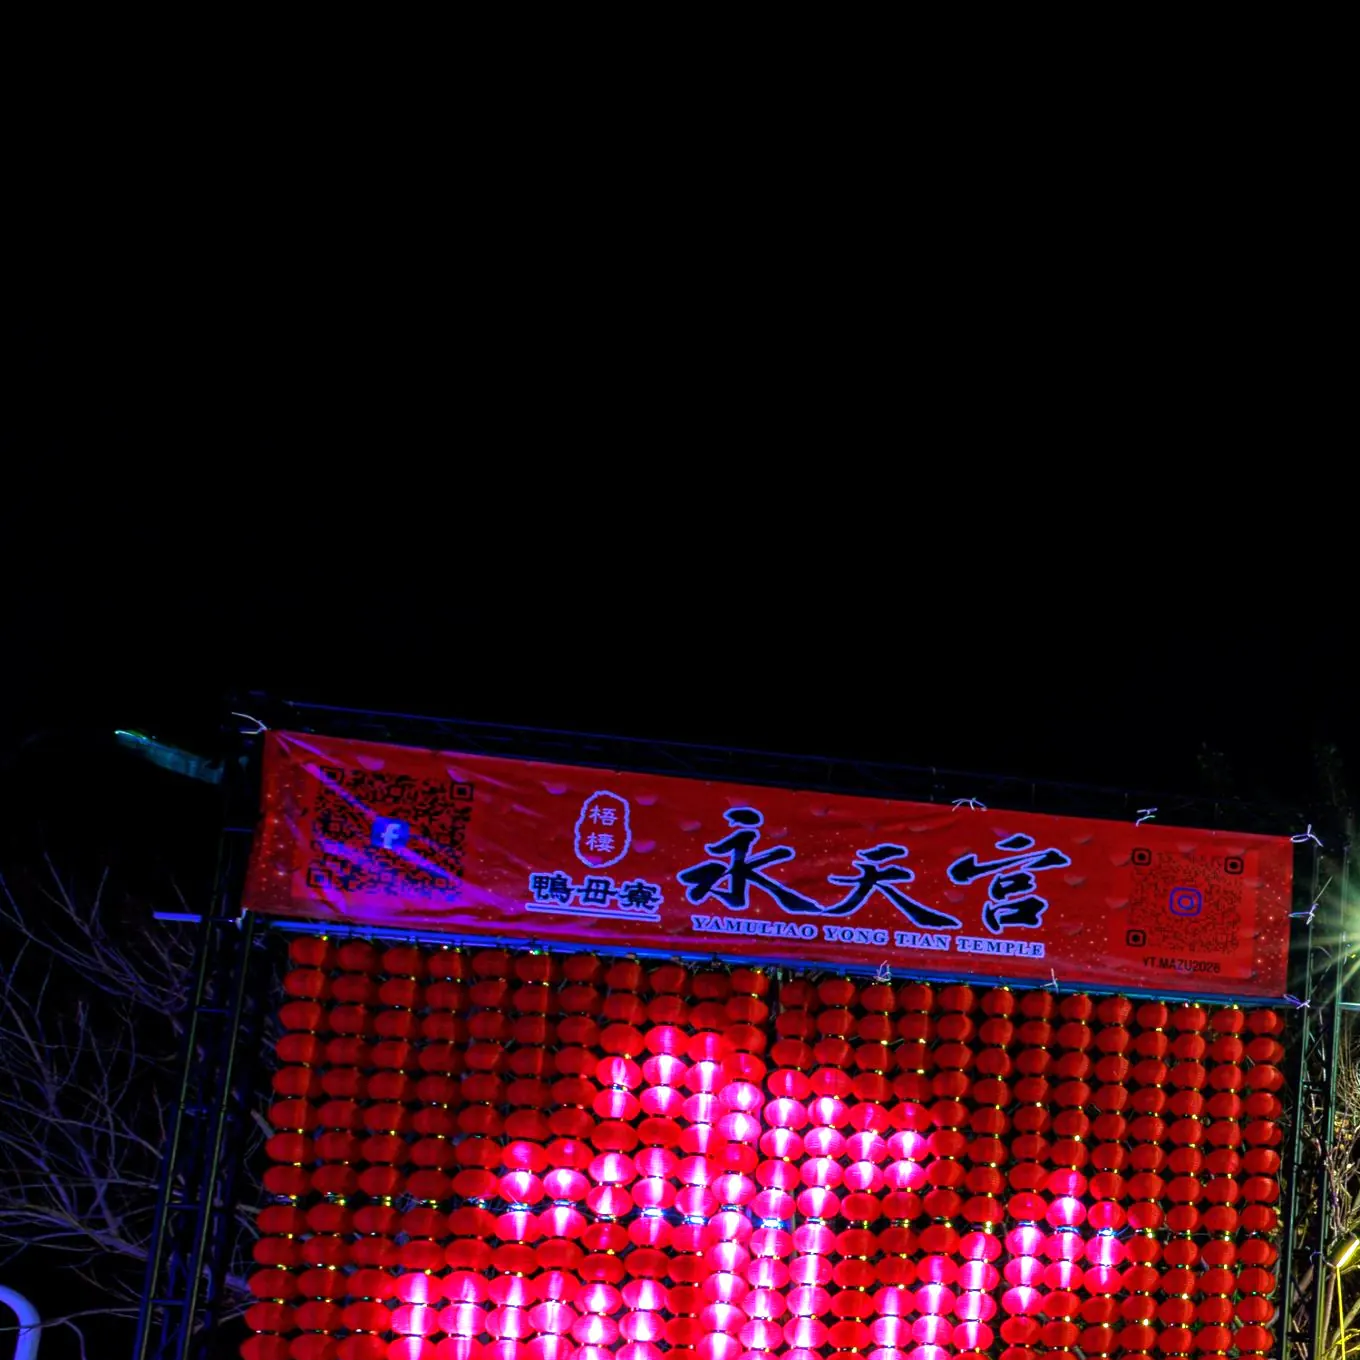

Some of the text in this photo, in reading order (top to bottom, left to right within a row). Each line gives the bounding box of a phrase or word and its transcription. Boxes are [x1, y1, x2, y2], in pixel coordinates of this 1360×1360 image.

[585, 805, 618, 852] 梧棲
[529, 871, 664, 914] 鴨母寮
[676, 806, 1072, 934] 永天宮
[691, 915, 1045, 957] YAMULIAO YONG TIAN TEMPLE
